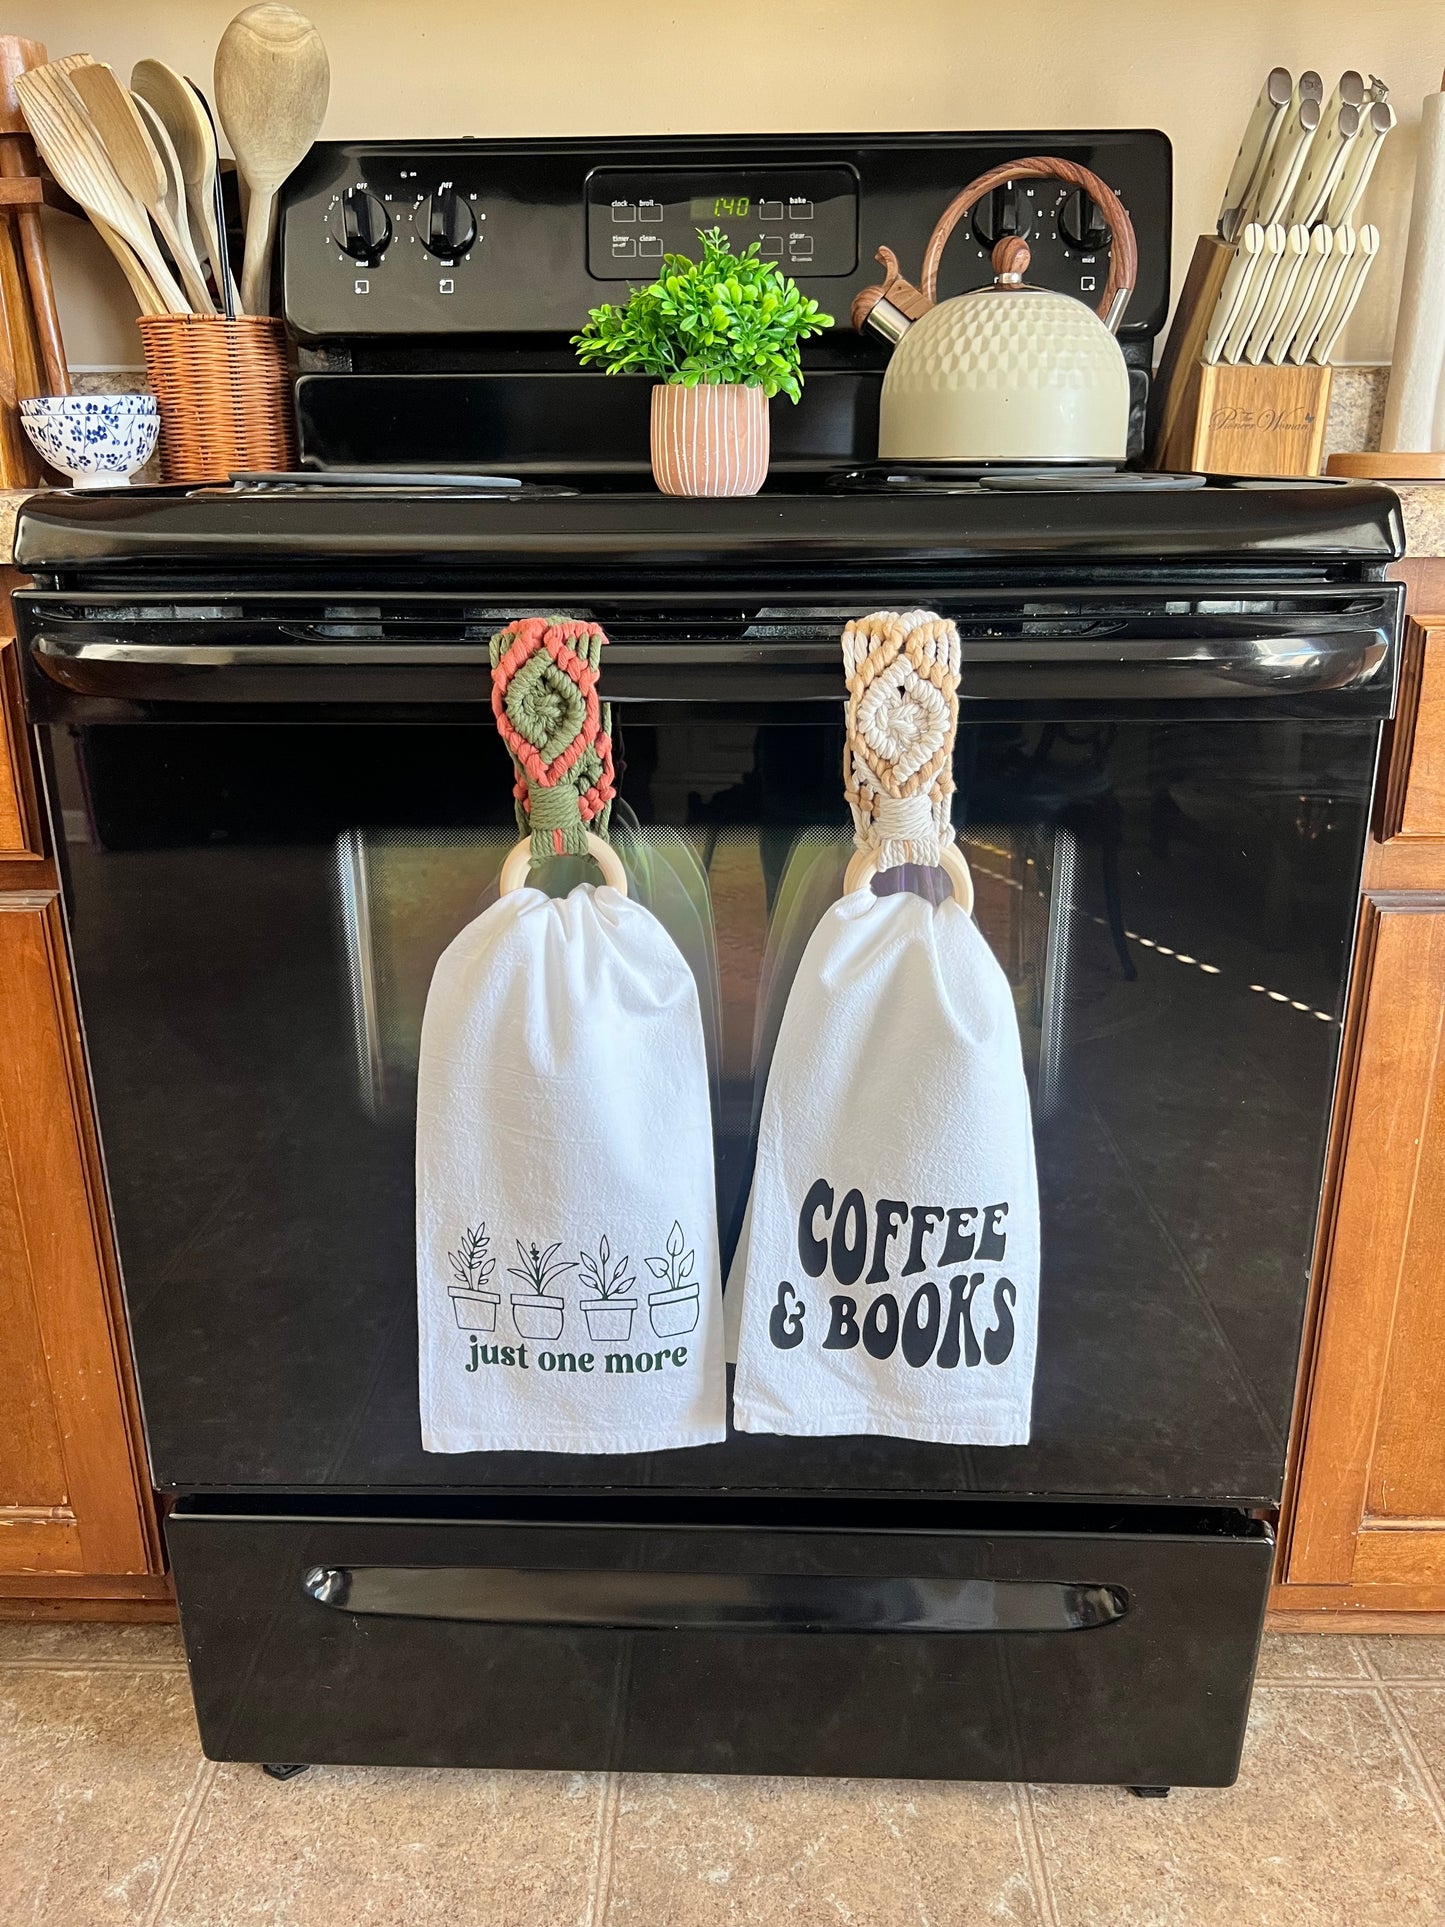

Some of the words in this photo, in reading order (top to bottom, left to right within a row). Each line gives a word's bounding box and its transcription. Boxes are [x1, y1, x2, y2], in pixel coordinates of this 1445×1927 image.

[798, 1178, 1009, 1286] COFFEE
[465, 1334, 529, 1373] just
[538, 1351, 594, 1372] one
[605, 1346, 688, 1373] more
[769, 1281, 806, 1349] &
[822, 1272, 1016, 1368] BOOKS
